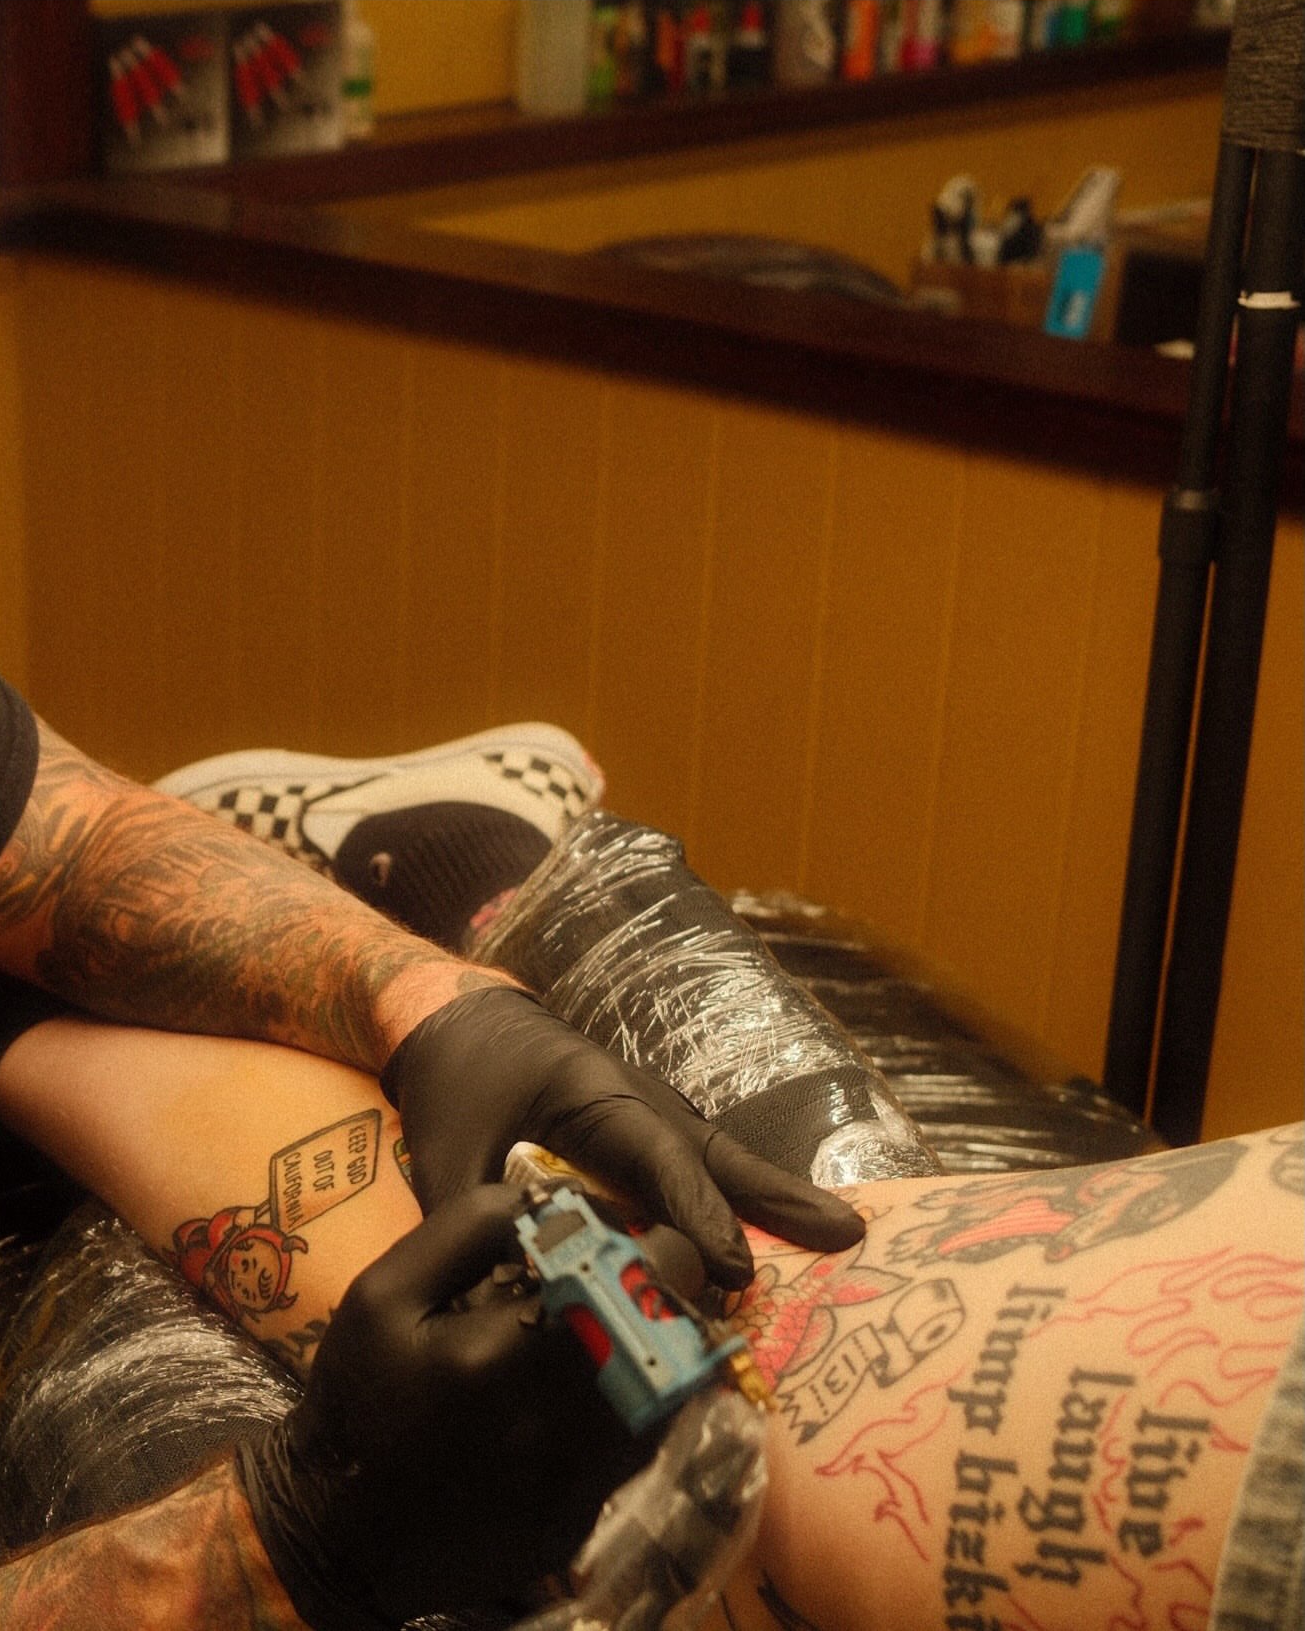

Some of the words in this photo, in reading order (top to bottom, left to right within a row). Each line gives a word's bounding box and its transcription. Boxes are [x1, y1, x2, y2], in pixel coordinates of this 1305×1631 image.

[313, 1150, 334, 1174] OUT
[347, 1155, 367, 1184] GOD
[348, 1123, 367, 1154] KEEP
[283, 1152, 303, 1229] CALIFORNIA
[312, 1175, 334, 1192] OF
[948, 1284, 1066, 1435] limp
[1013, 1367, 1136, 1588] laugh
[1117, 1408, 1211, 1558] live
[943, 1450, 1018, 1631] bizki
